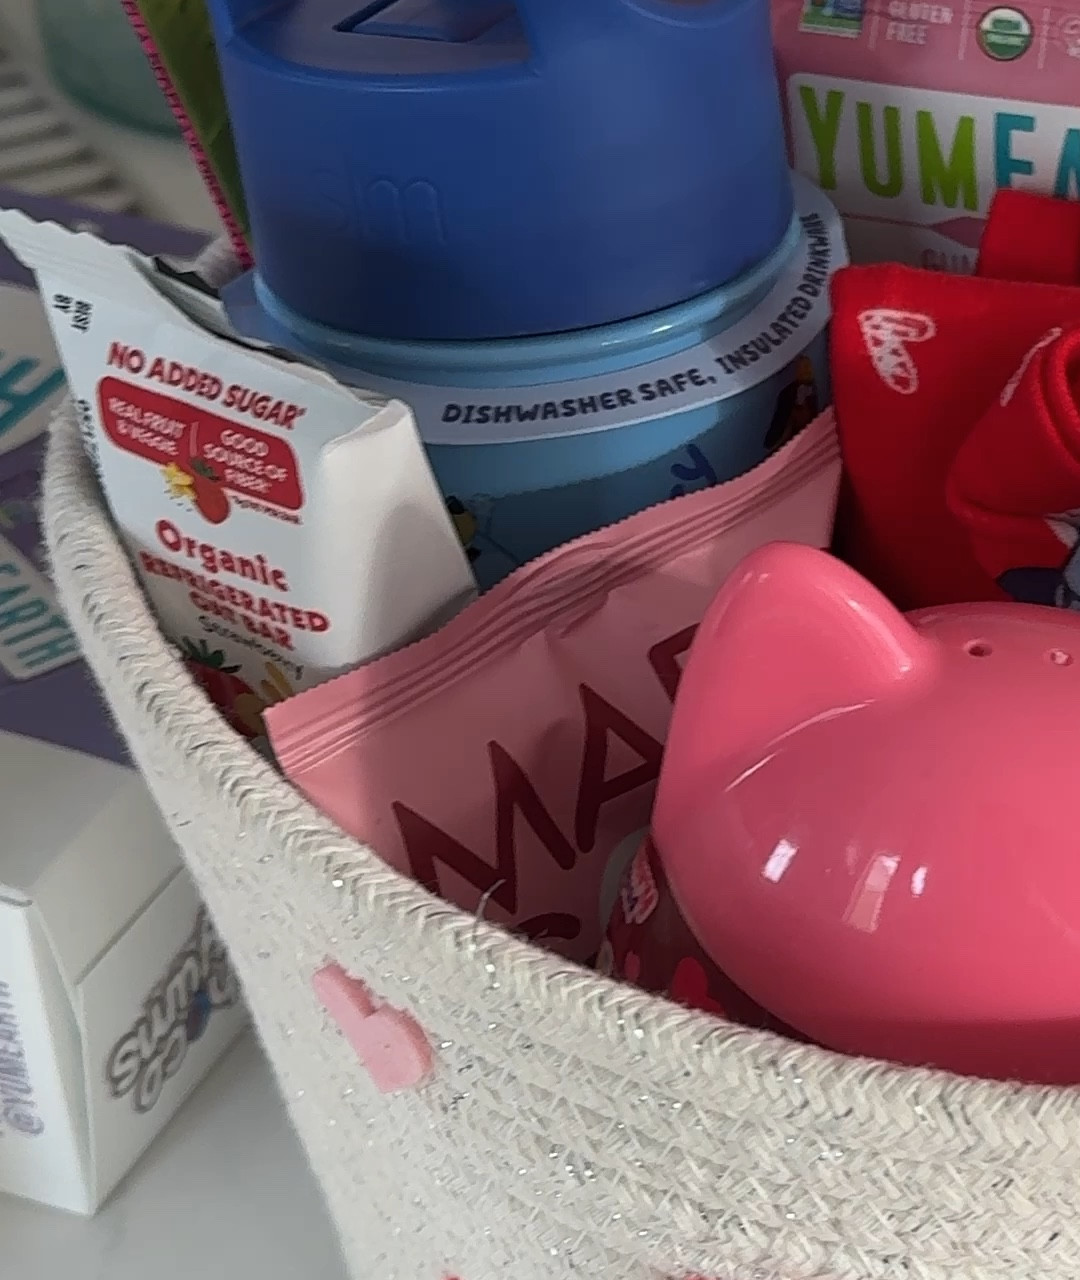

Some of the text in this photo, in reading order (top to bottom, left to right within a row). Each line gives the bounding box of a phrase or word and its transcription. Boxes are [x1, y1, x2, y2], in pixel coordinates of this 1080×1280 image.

[885, 20, 928, 46] FREE
[441, 212, 832, 425] DISHWASHER SAFE, INSULATED DRINKWARE
[106, 341, 147, 374] NO
[146, 357, 223, 401] ADDED
[219, 429, 270, 457] GOOD
[155, 518, 291, 593] Organic
